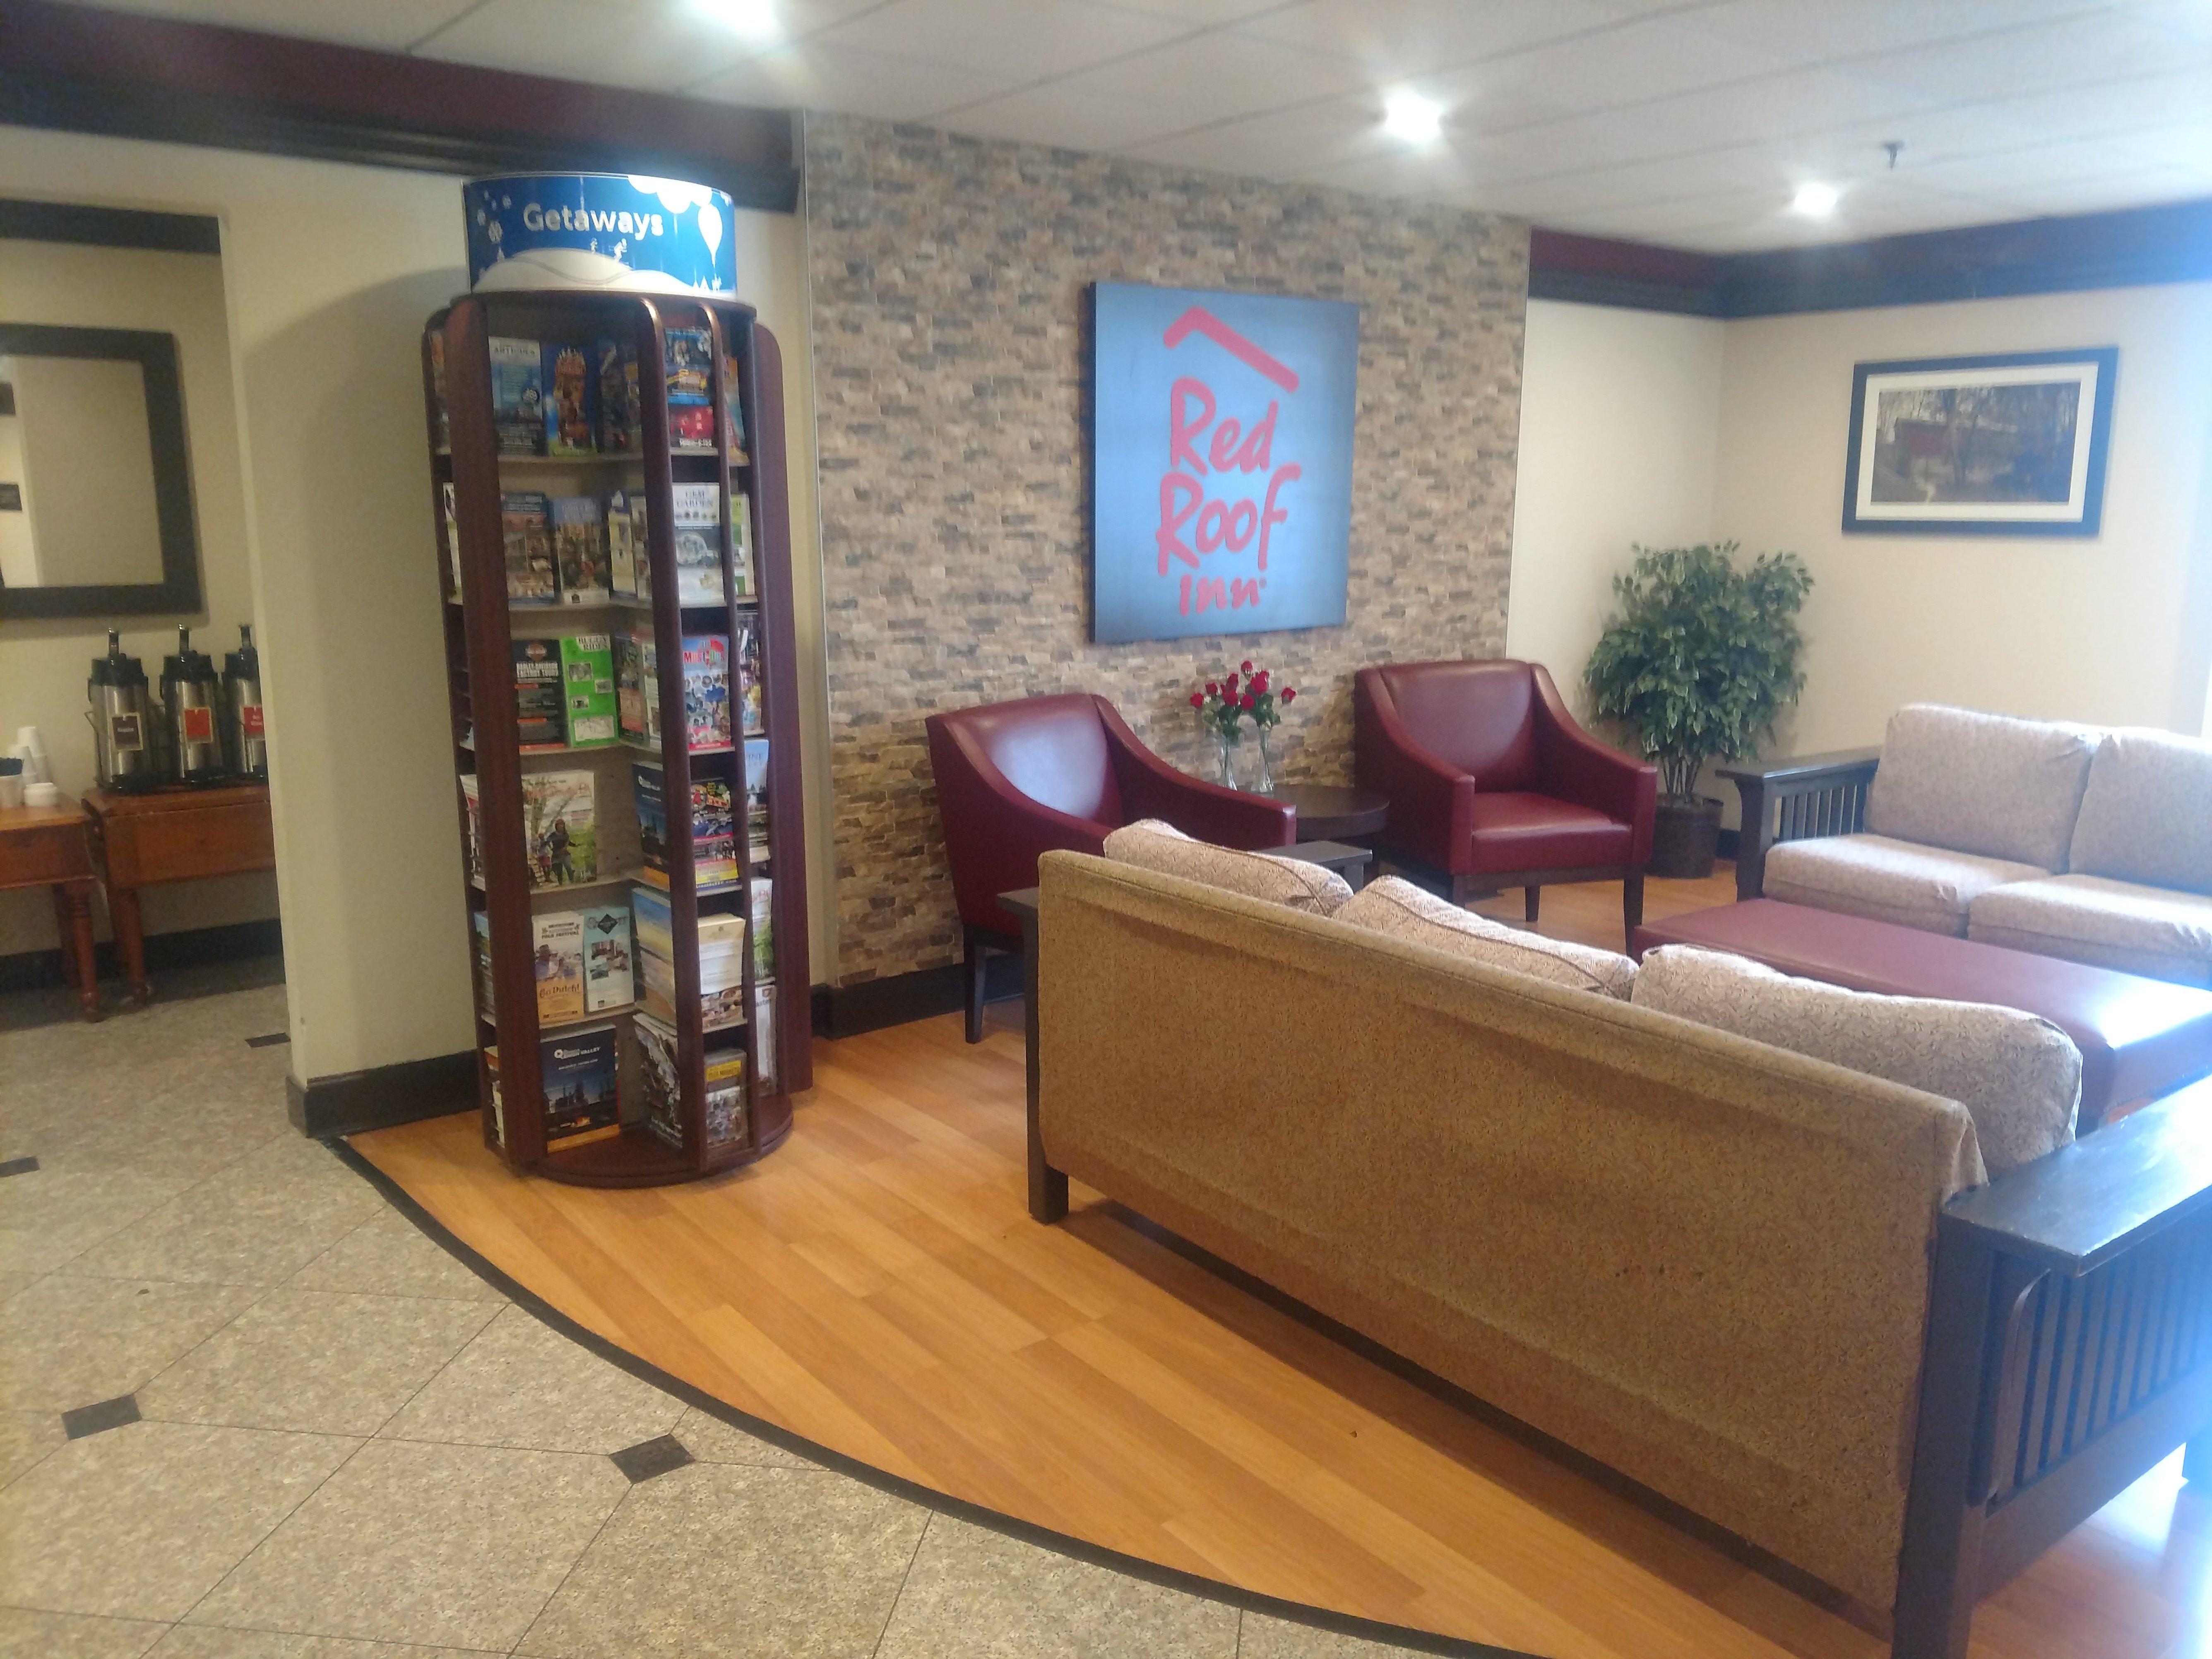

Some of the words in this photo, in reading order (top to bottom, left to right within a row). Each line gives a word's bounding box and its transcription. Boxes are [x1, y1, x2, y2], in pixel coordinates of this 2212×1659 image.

[523, 202, 664, 240] Getaways
[1170, 376, 1279, 476] Red
[1156, 462, 1301, 577] Roof
